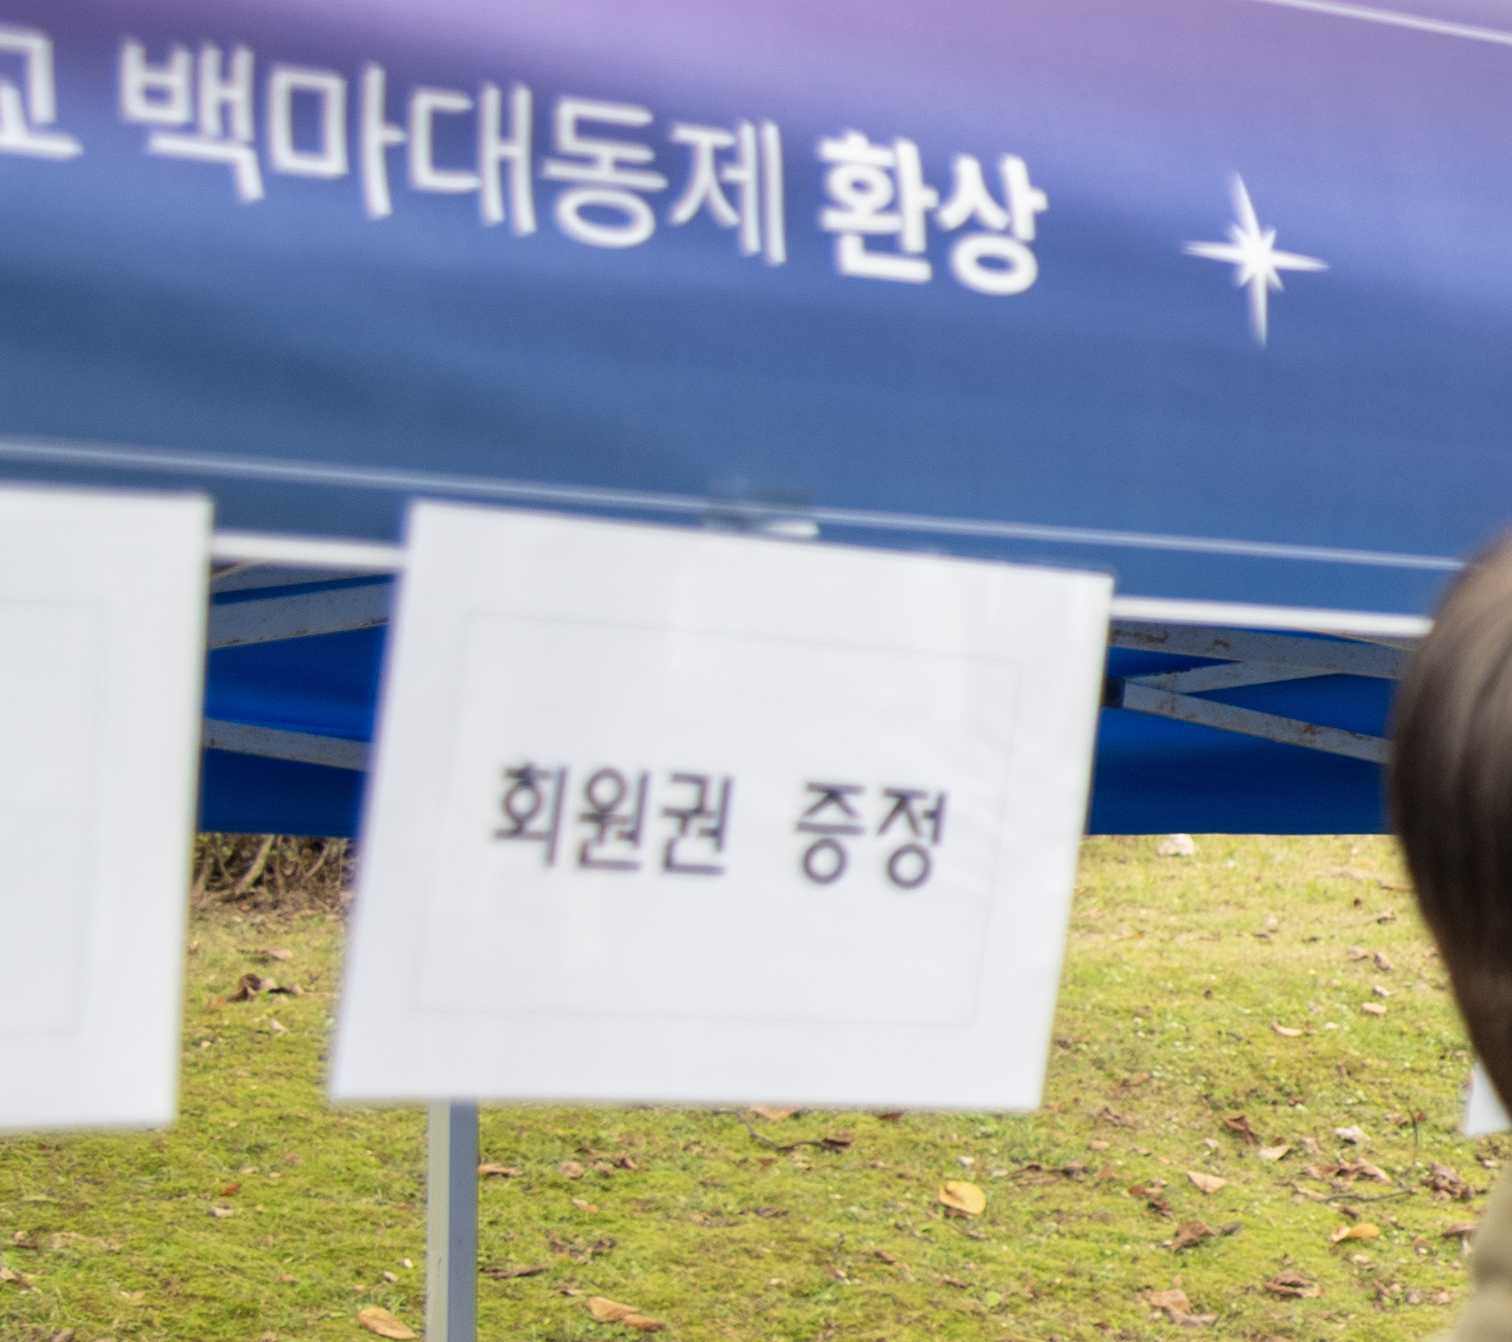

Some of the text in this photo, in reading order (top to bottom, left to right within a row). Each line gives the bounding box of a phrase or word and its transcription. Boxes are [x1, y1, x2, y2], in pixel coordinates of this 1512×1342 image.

[120, 39, 787, 268] 백마대동제
[817, 127, 1048, 296] 환상
[490, 760, 948, 890] 회원권 증정
